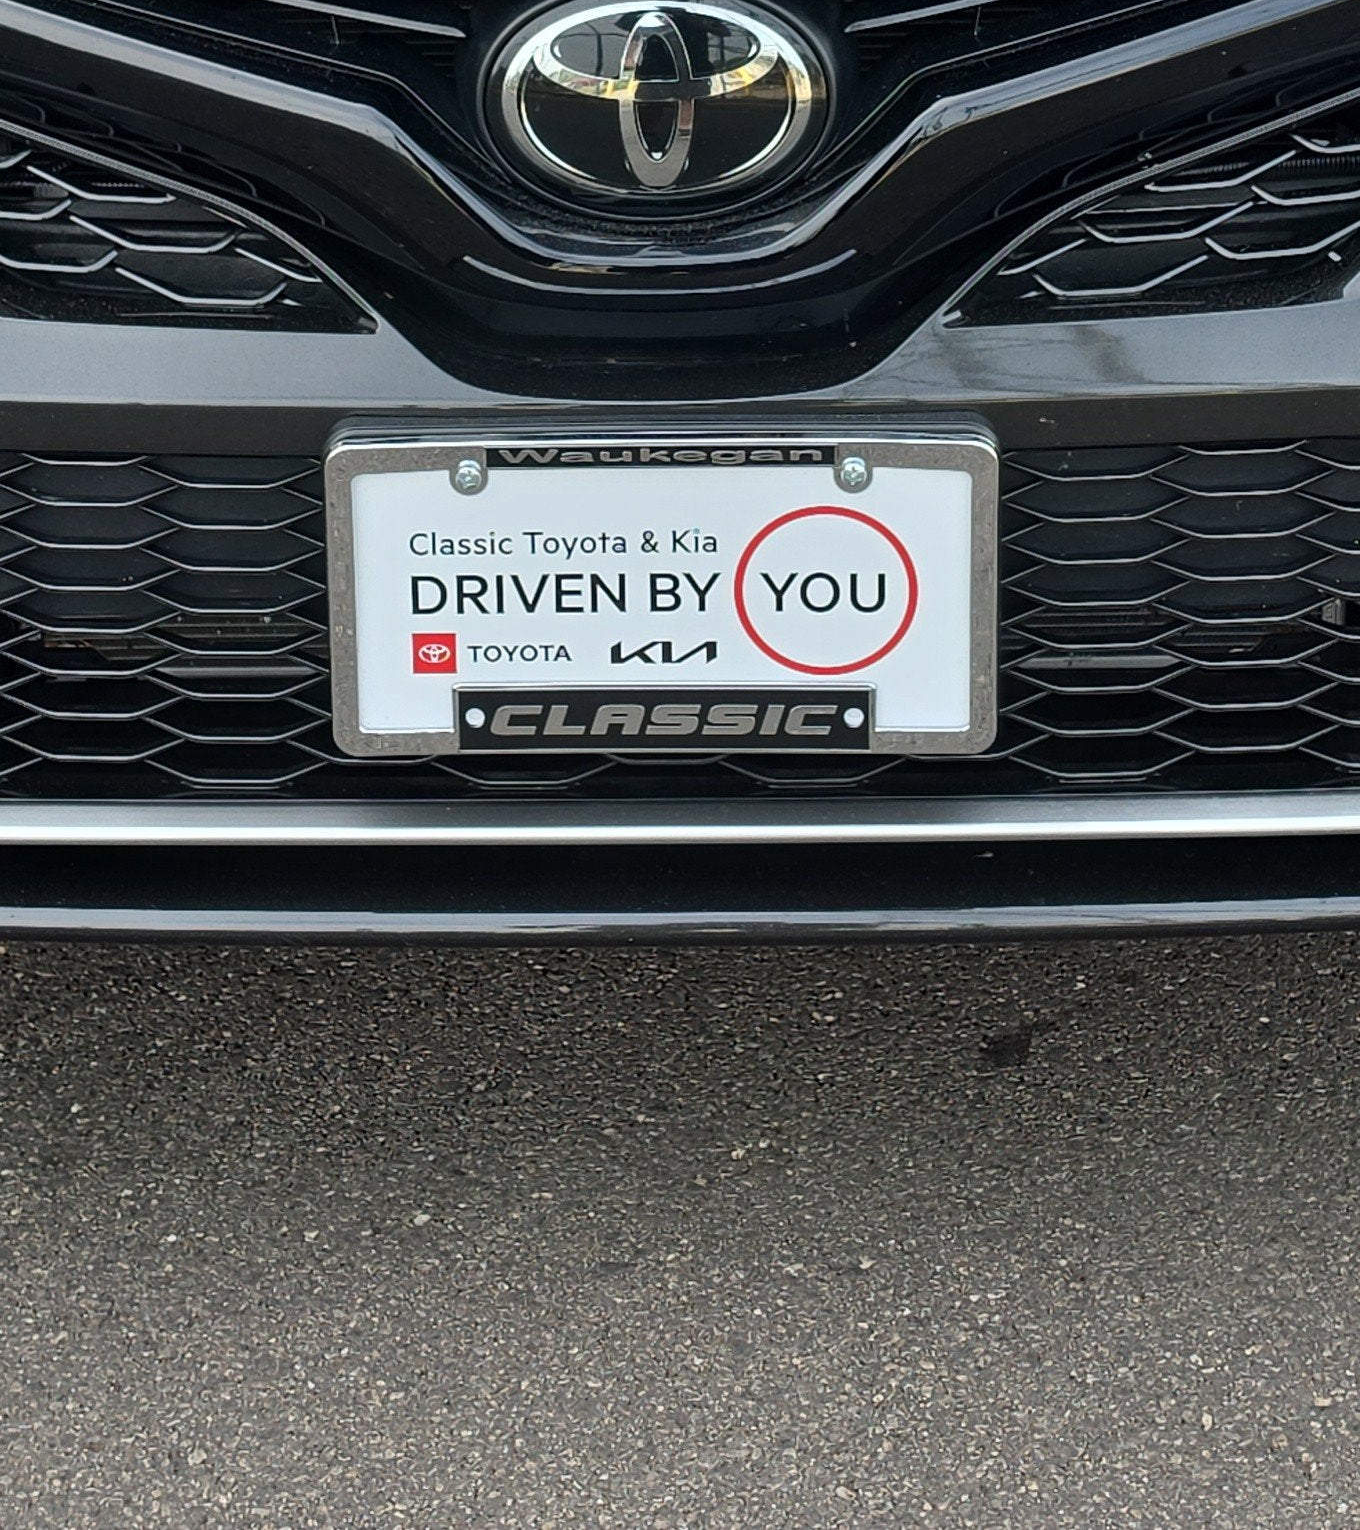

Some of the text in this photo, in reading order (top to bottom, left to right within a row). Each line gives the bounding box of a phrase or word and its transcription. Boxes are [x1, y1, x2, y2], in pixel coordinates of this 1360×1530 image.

[498, 448, 822, 465] Waukegan
[409, 529, 718, 560] Classic Toyota & Kia
[411, 571, 886, 615] DRIVEN BY YOU
[467, 644, 572, 663] TOYOTA
[490, 704, 839, 736] CLASSIC
